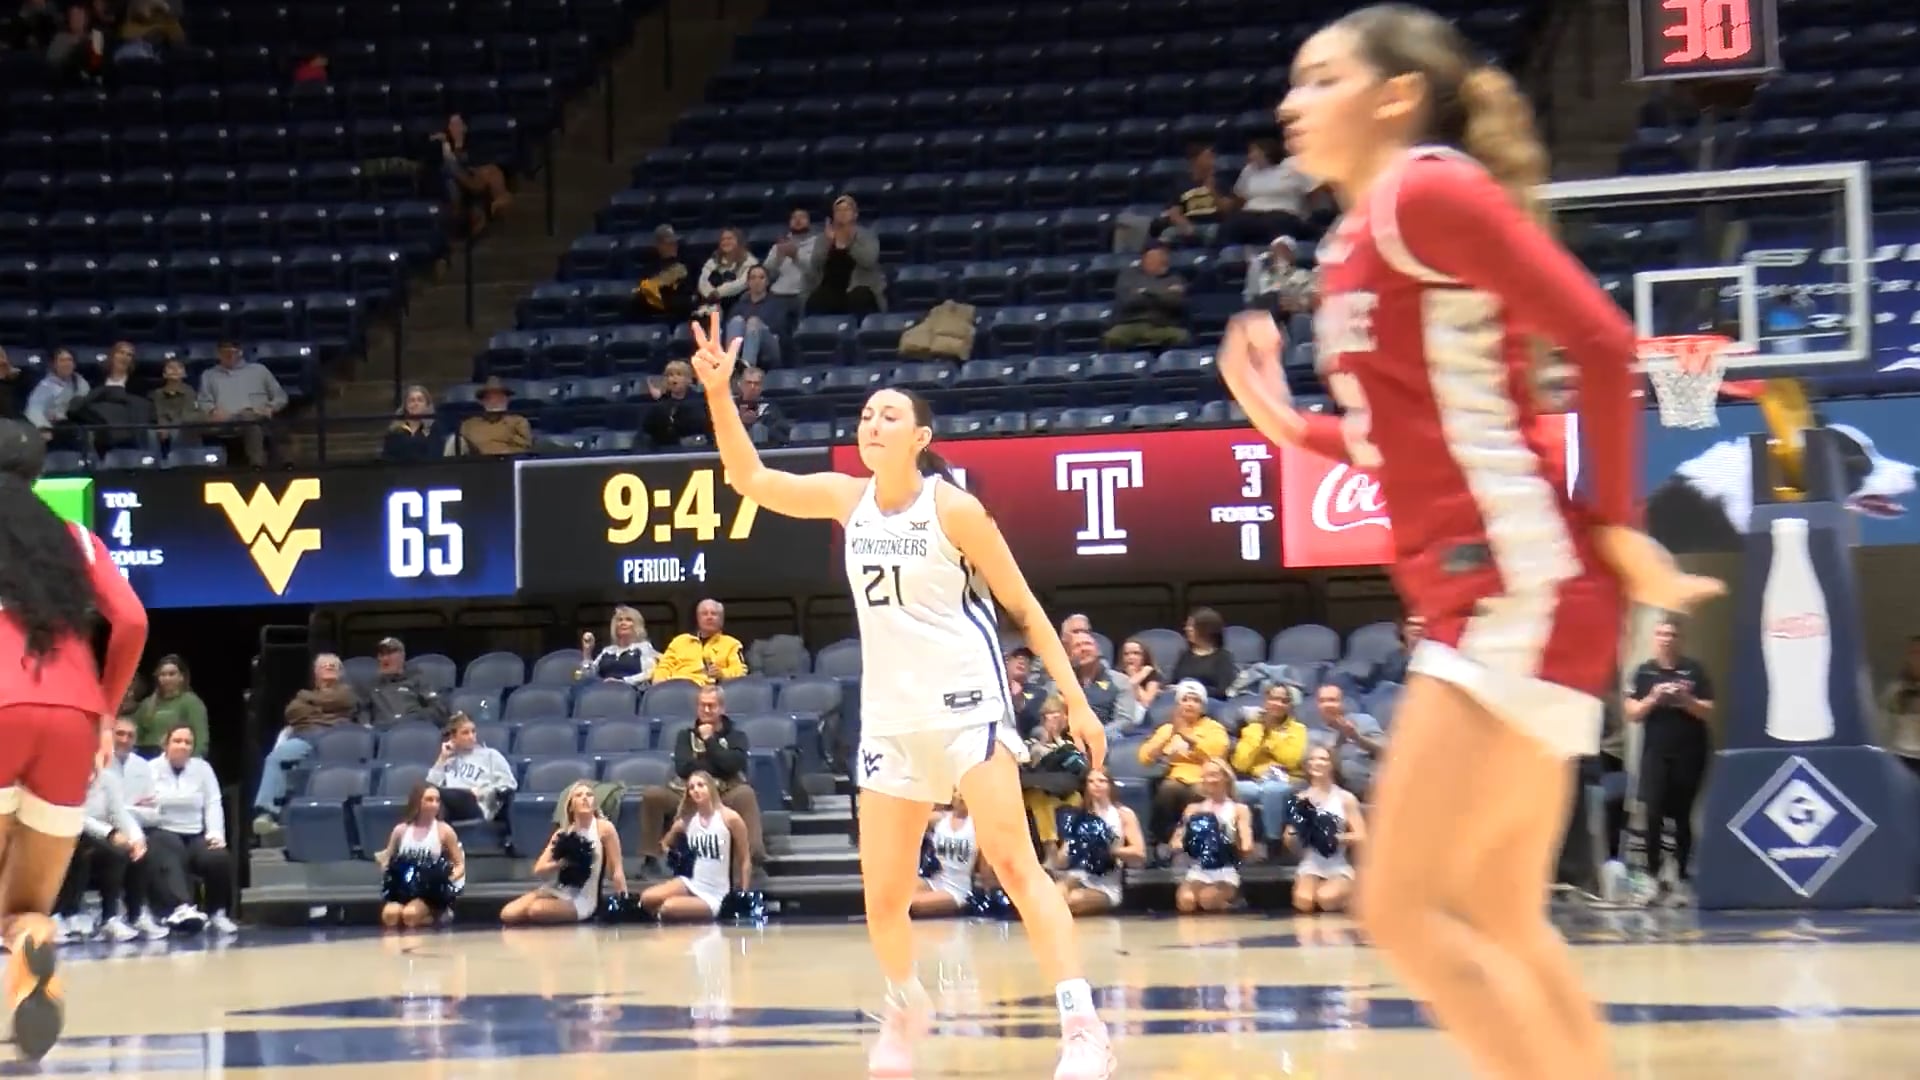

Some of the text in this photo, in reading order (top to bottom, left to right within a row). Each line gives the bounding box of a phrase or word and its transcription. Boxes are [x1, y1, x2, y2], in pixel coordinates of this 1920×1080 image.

[1662, 0, 1752, 63] 30
[1231, 443, 1273, 460] TOL
[1240, 460, 1262, 498] 3
[102, 492, 142, 508] TOL
[112, 510, 132, 546] 4
[387, 488, 464, 578] 65
[851, 536, 928, 557] MOUNTAINEERS
[1240, 523, 1261, 561] 0
[623, 552, 707, 584] PERIOD: 4
[862, 563, 906, 608] 21
